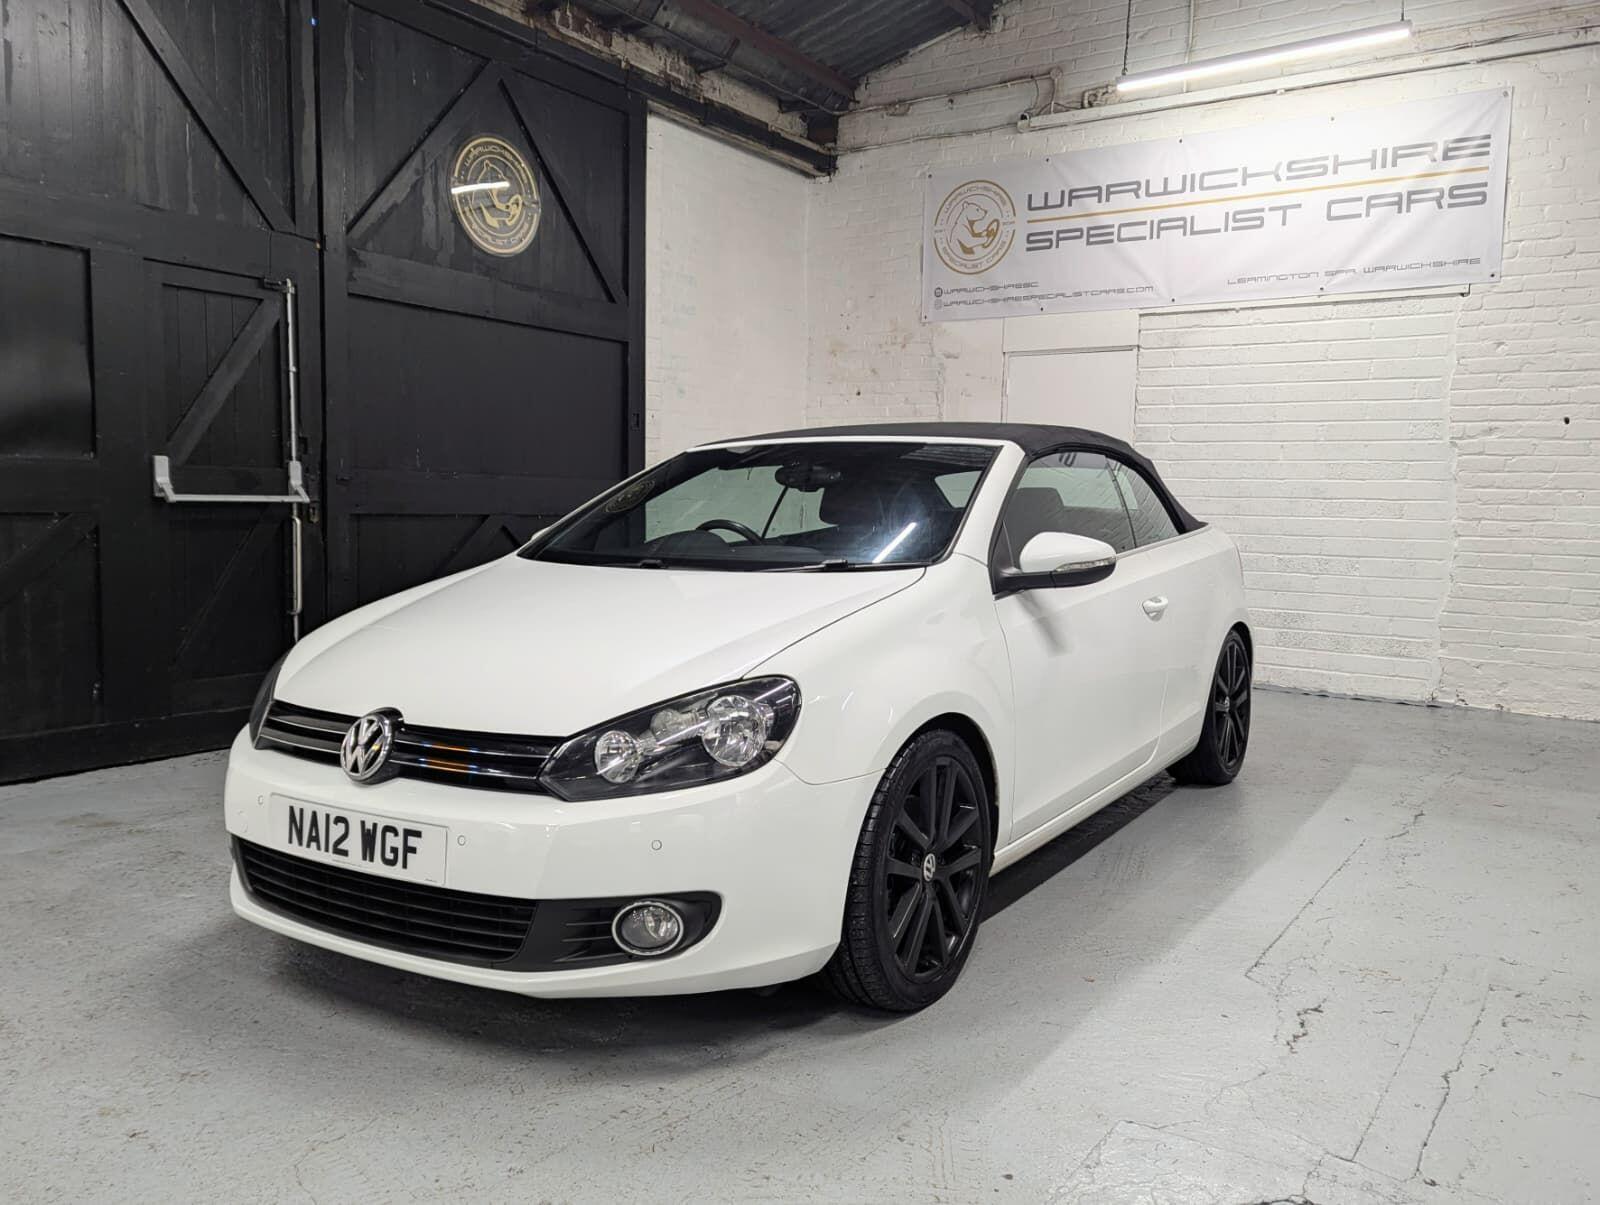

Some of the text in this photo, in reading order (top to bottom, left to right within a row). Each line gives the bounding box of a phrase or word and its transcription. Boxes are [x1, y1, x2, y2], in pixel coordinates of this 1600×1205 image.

[1027, 134, 1492, 211] WARWICKSHIRE
[1025, 181, 1488, 252] SPECIALIST CARS
[288, 805, 423, 870] NA12 WGF
